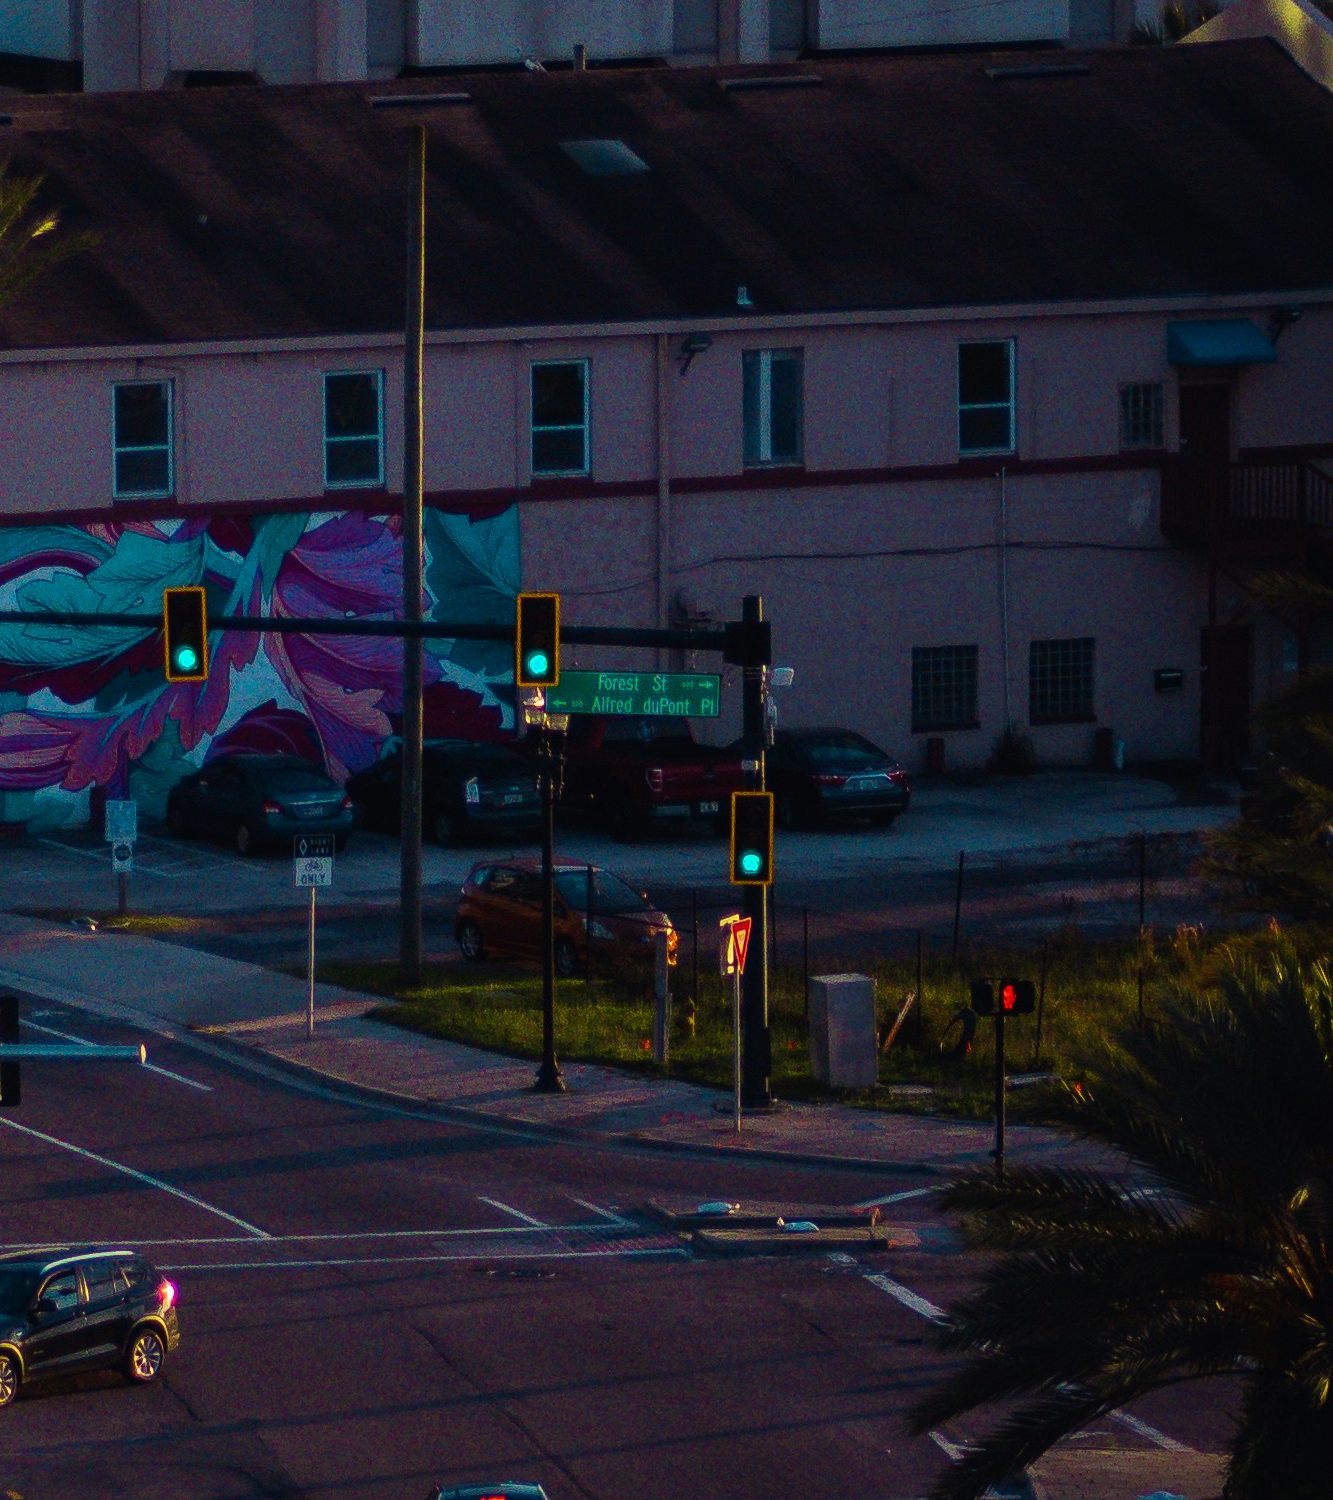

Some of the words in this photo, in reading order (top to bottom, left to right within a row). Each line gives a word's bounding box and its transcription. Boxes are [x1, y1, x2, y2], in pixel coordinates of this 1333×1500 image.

[598, 673, 639, 692] Forest
[652, 673, 667, 692] St
[591, 696, 633, 714] Alfred
[643, 697, 690, 715] duPont
[300, 873, 326, 885] ONLY
